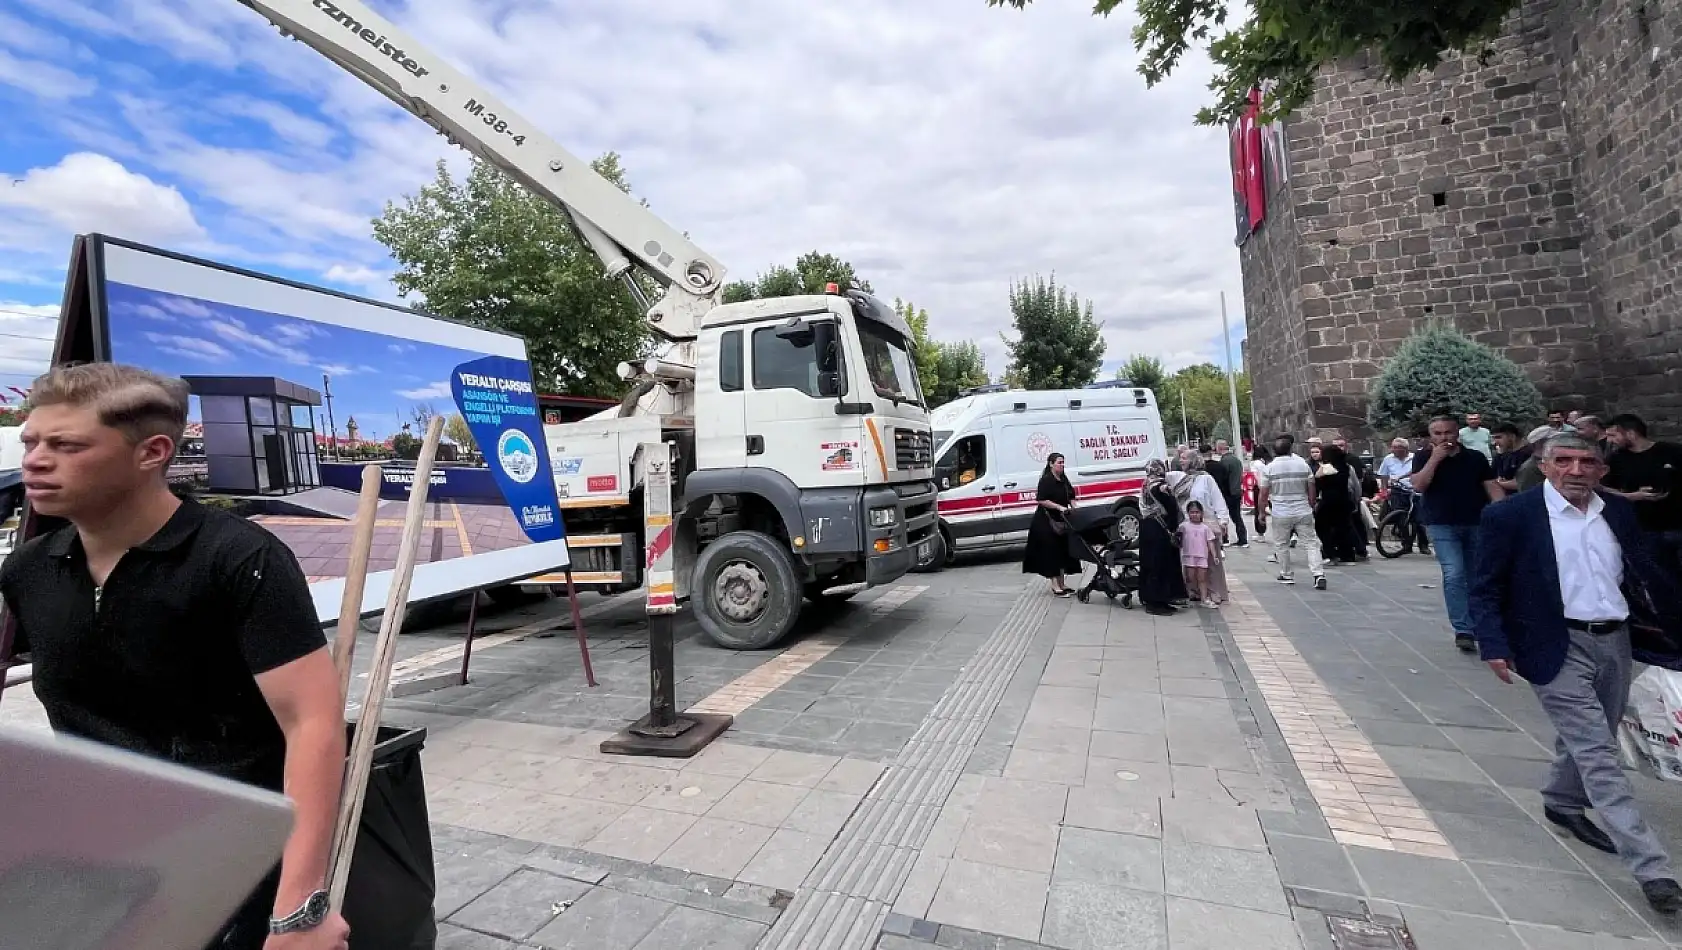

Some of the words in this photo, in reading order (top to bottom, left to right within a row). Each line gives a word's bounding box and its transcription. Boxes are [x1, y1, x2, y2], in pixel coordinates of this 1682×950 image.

[459, 372, 498, 389] YERALTI
[498, 378, 533, 395] ÇARŞISI
[463, 390, 498, 401] ASANSÖR
[499, 393, 509, 403] VE
[1106, 424, 1120, 435] T.C.
